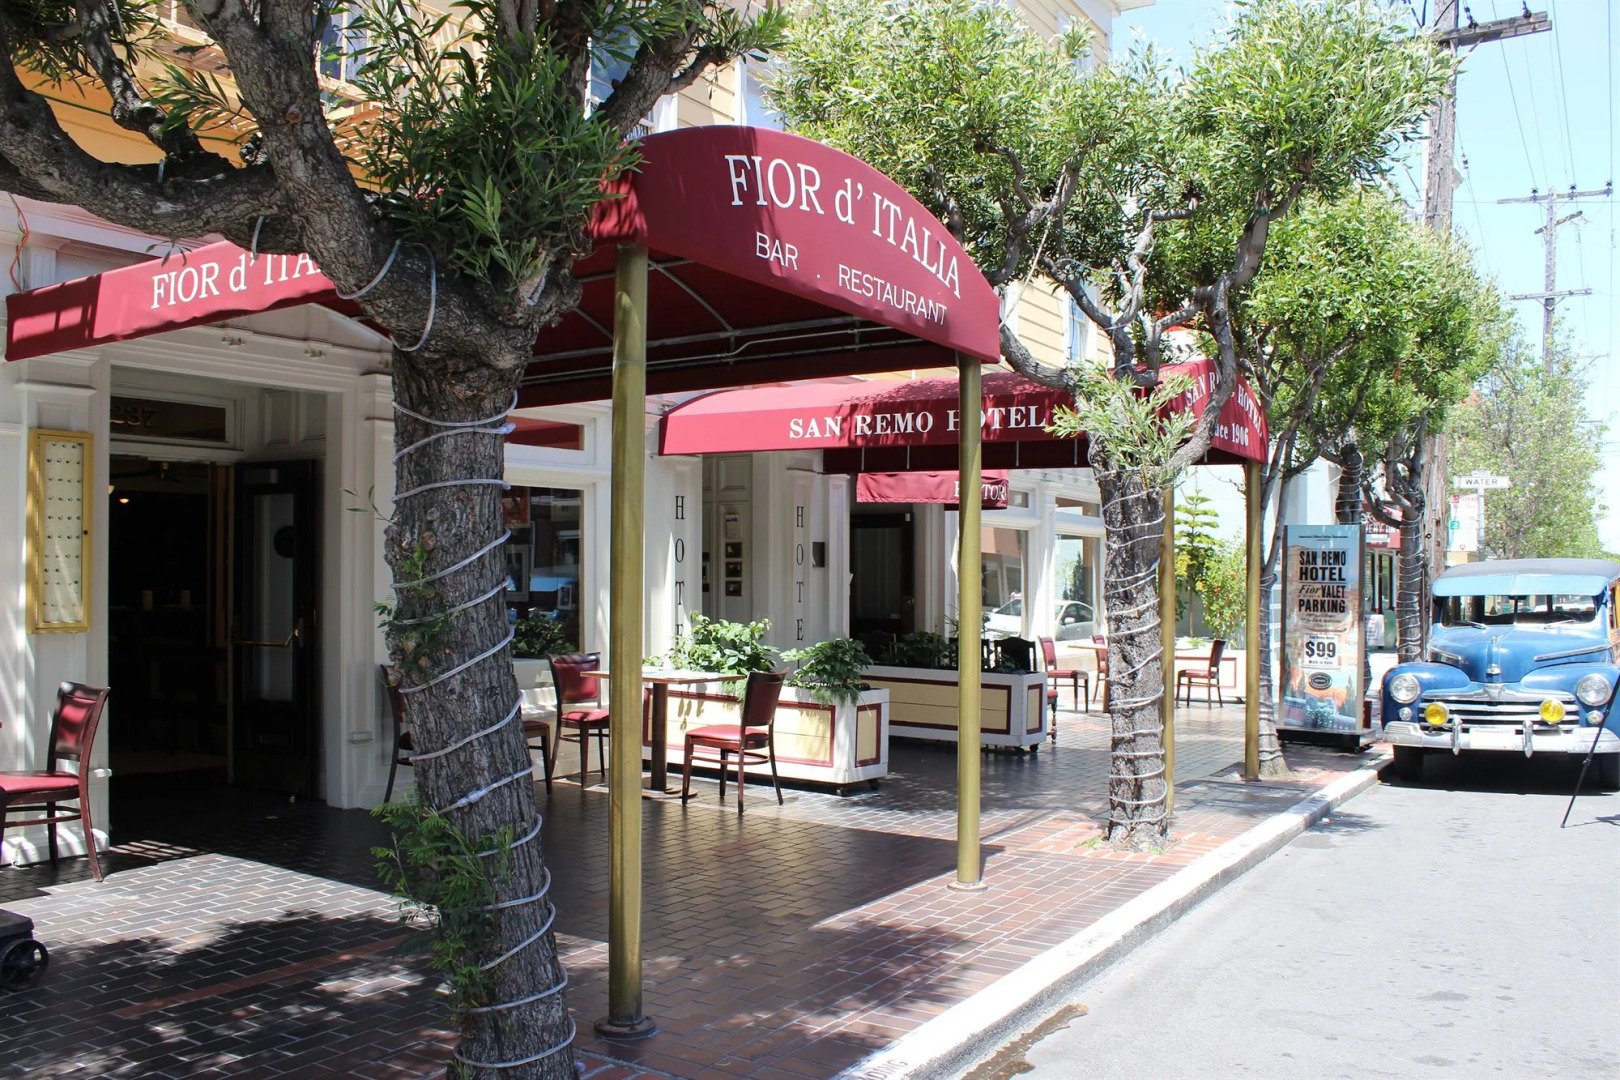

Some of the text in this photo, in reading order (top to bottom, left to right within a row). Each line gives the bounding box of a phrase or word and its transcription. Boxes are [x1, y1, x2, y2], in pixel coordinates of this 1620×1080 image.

[725, 154, 825, 215] FIOR
[872, 192, 961, 299] ITALIA
[150, 262, 220, 309] FIOR
[264, 253, 321, 286] ITA
[755, 231, 947, 325] BAR RESTAURANT
[1186, 373, 1206, 407] SAN
[1237, 384, 1262, 438] HOTEL
[789, 405, 1046, 439] SAN REMO HTEL
[1231, 422, 1249, 447] 1906
[1465, 478, 1498, 486] WATER
[1299, 550, 1346, 566] SAN REMO
[796, 506, 804, 641] HOTE
[1299, 566, 1346, 582] HOTEL
[1298, 584, 1346, 599] Fior VALET
[1298, 599, 1346, 613] PARKING
[1305, 640, 1336, 659] $99
